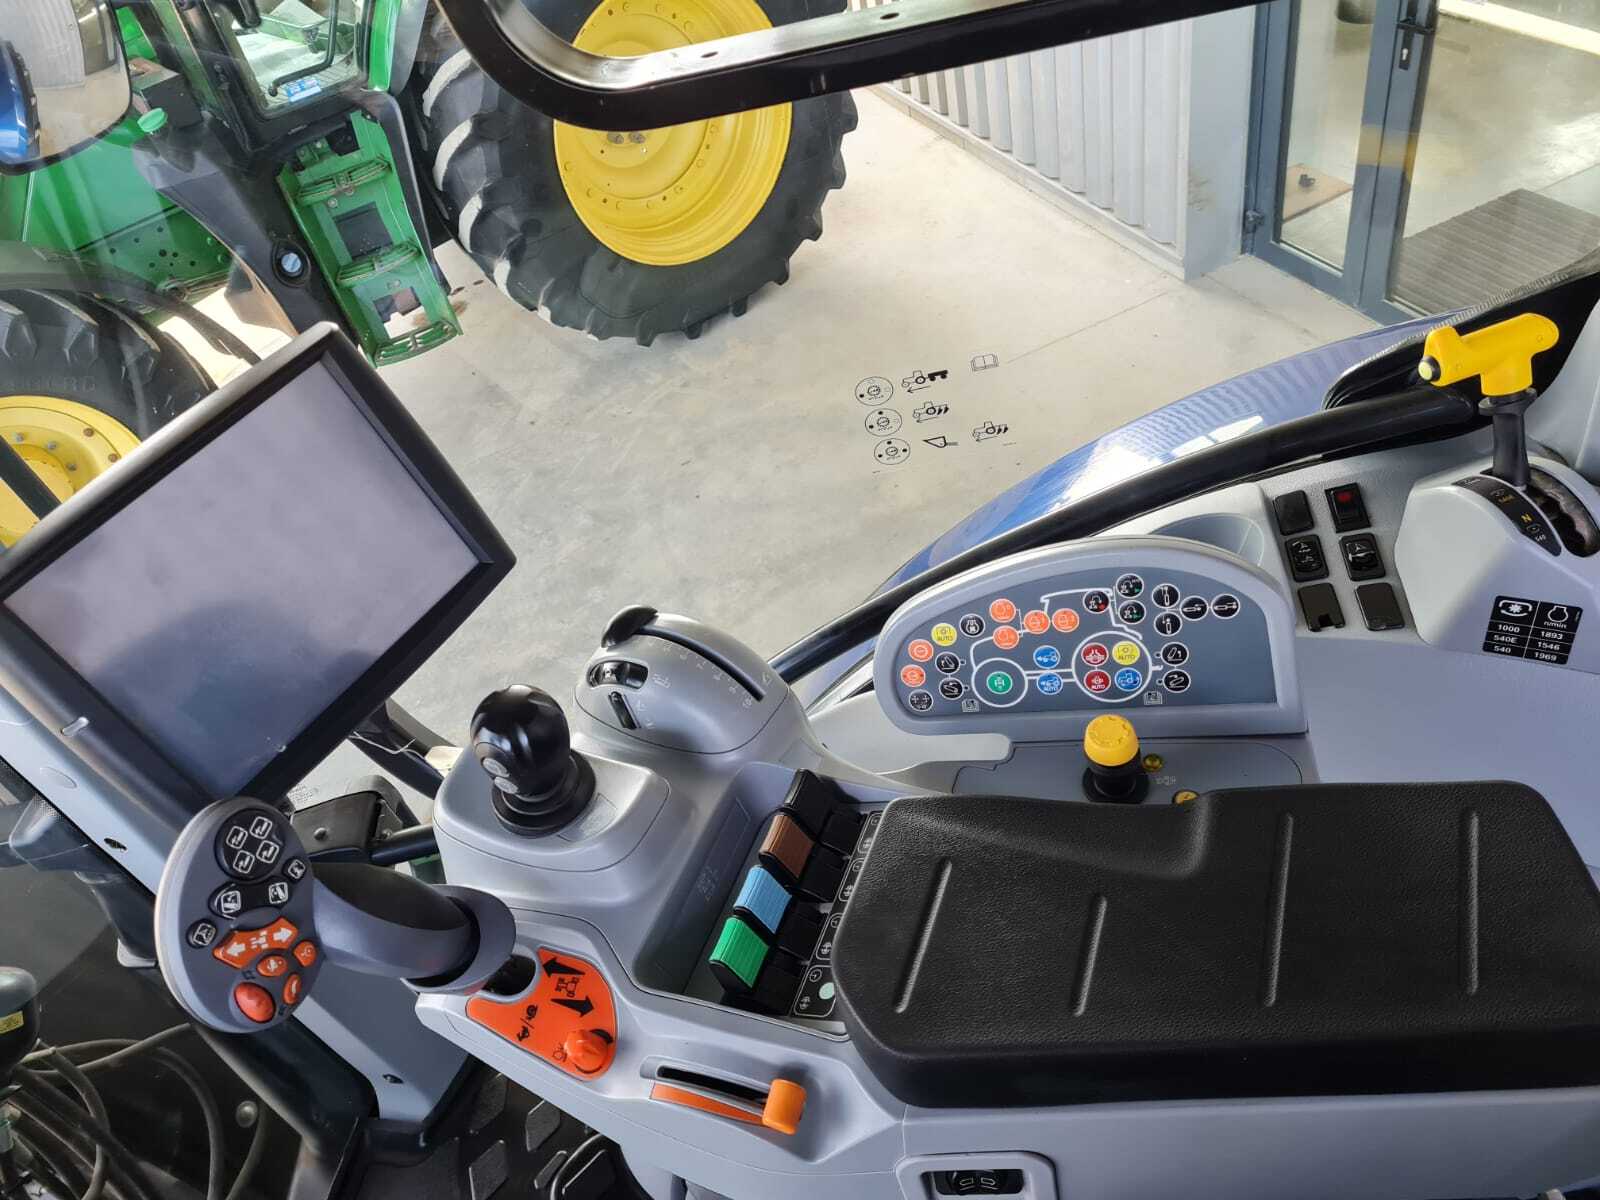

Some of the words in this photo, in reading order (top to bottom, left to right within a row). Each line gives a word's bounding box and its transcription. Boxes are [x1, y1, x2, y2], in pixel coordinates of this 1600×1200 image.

[1497, 624, 1520, 633] 1000
[1493, 634, 1517, 644] 540E
[1541, 631, 1563, 640] 1893
[1494, 645, 1511, 654] 540
[1537, 641, 1560, 651] 1546
[1534, 651, 1557, 661] 1969
